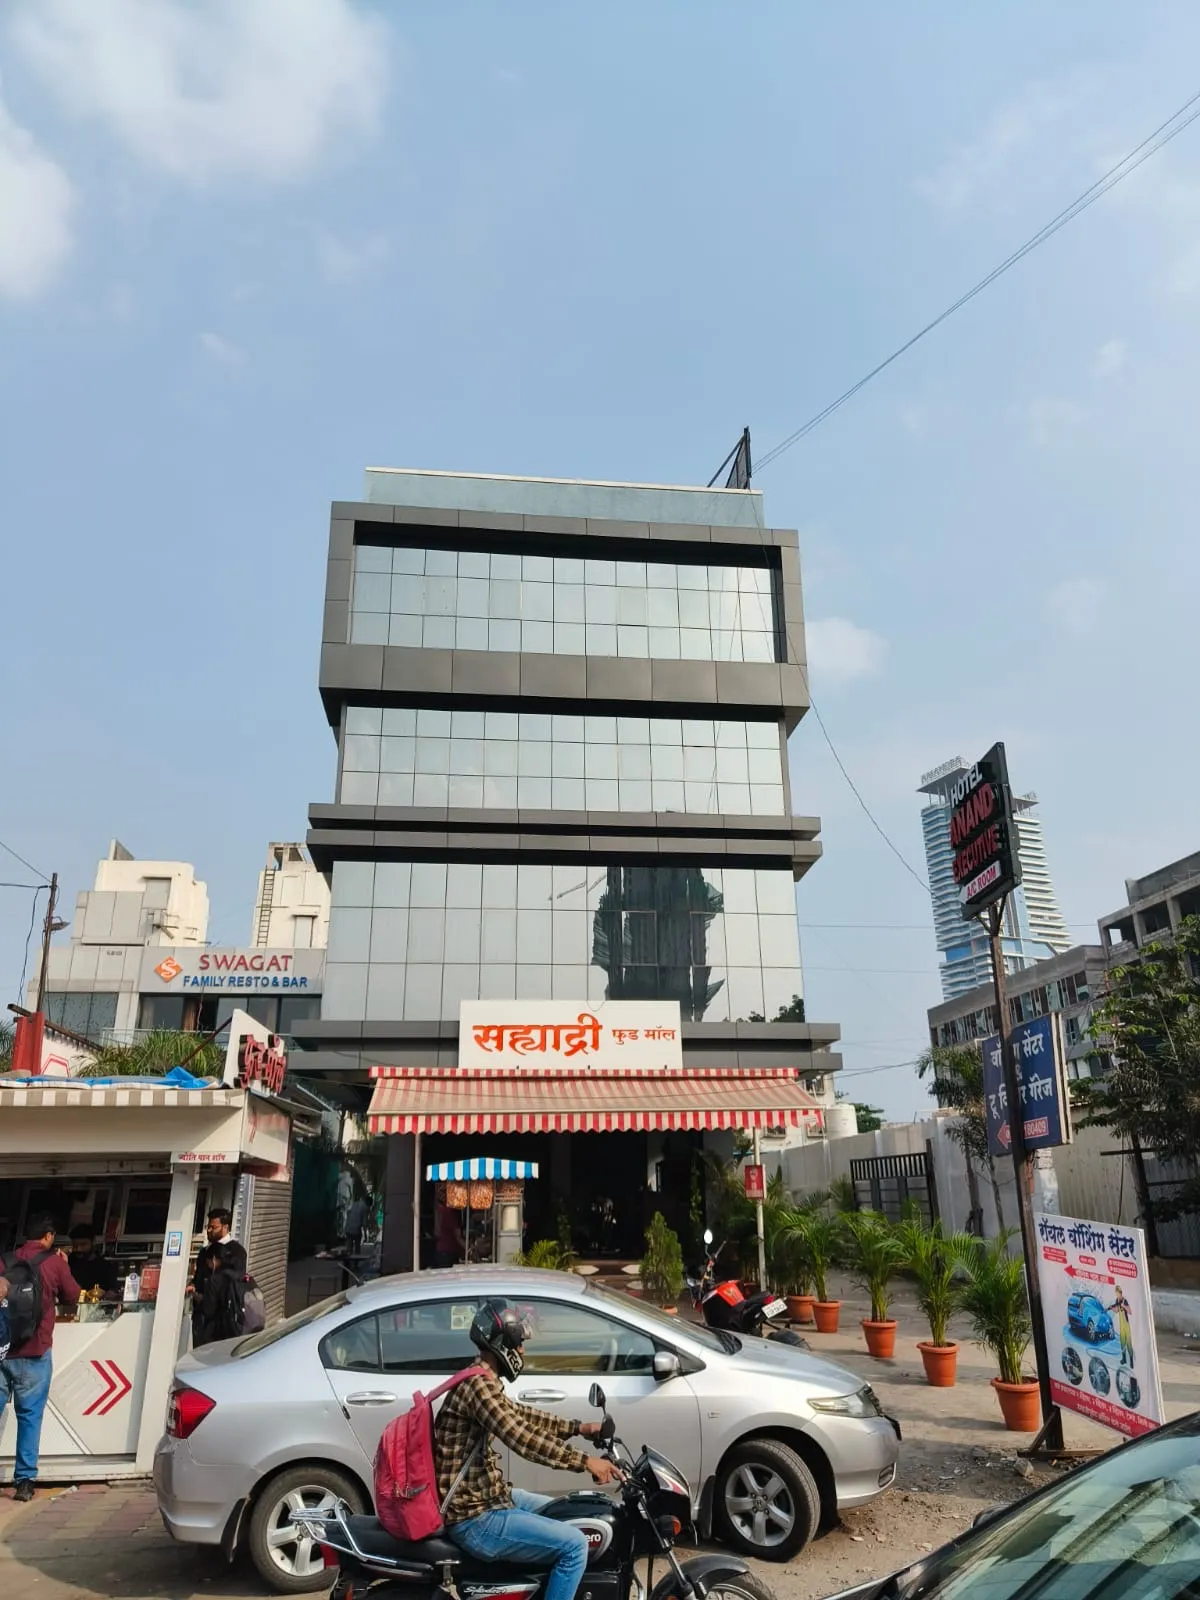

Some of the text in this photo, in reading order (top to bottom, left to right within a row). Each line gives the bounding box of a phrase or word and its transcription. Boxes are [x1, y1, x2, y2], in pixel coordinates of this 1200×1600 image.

[950, 761, 983, 808] HOTEL
[949, 783, 995, 848] ANAND
[951, 823, 999, 885] EXECUTIVE
[966, 865, 997, 900] A/C ROOM
[183, 975, 308, 988] FAMILY RESTO & BAR
[198, 954, 293, 972] SWAGAT
[472, 1012, 676, 1057] सह्याद्री फुड मॉल
[1021, 1028, 1045, 1058] सेंटर
[1038, 1217, 1137, 1260] रॉयल वॉशिंग सेंटर
